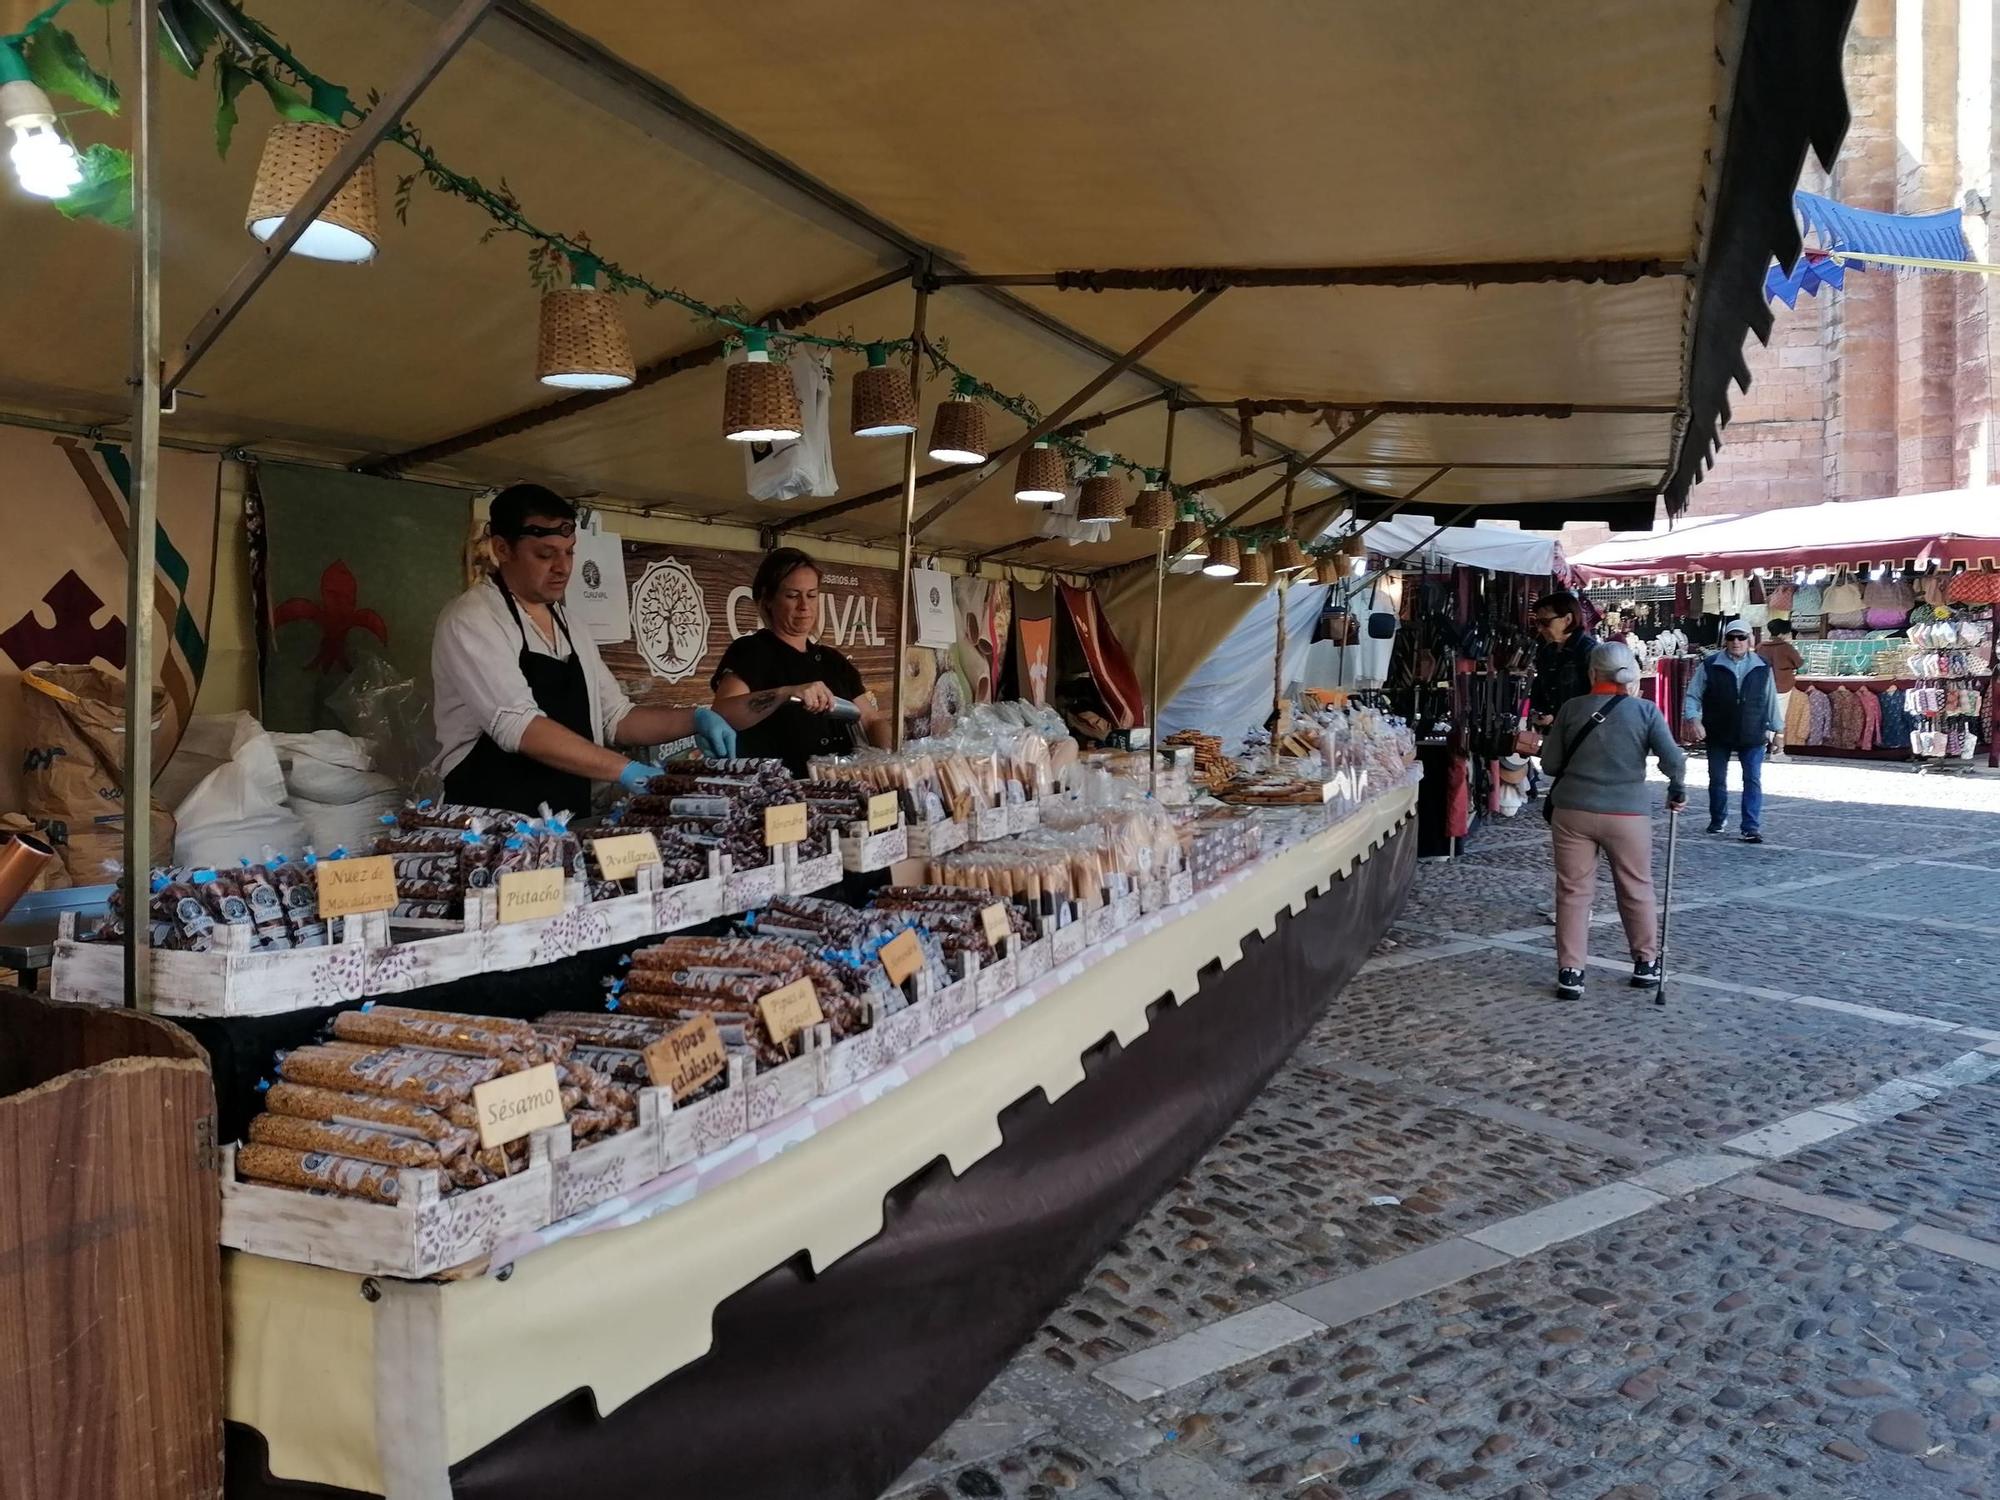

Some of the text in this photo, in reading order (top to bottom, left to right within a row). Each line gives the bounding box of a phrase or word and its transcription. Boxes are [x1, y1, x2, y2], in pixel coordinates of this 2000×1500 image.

[821, 573, 860, 586] esanos.es
[658, 734, 698, 760] SERAFINA
[605, 849, 658, 867] Avellana
[328, 869, 368, 886] Nuez
[506, 883, 560, 907] Pistacho
[487, 1088, 554, 1126] Sésamo
